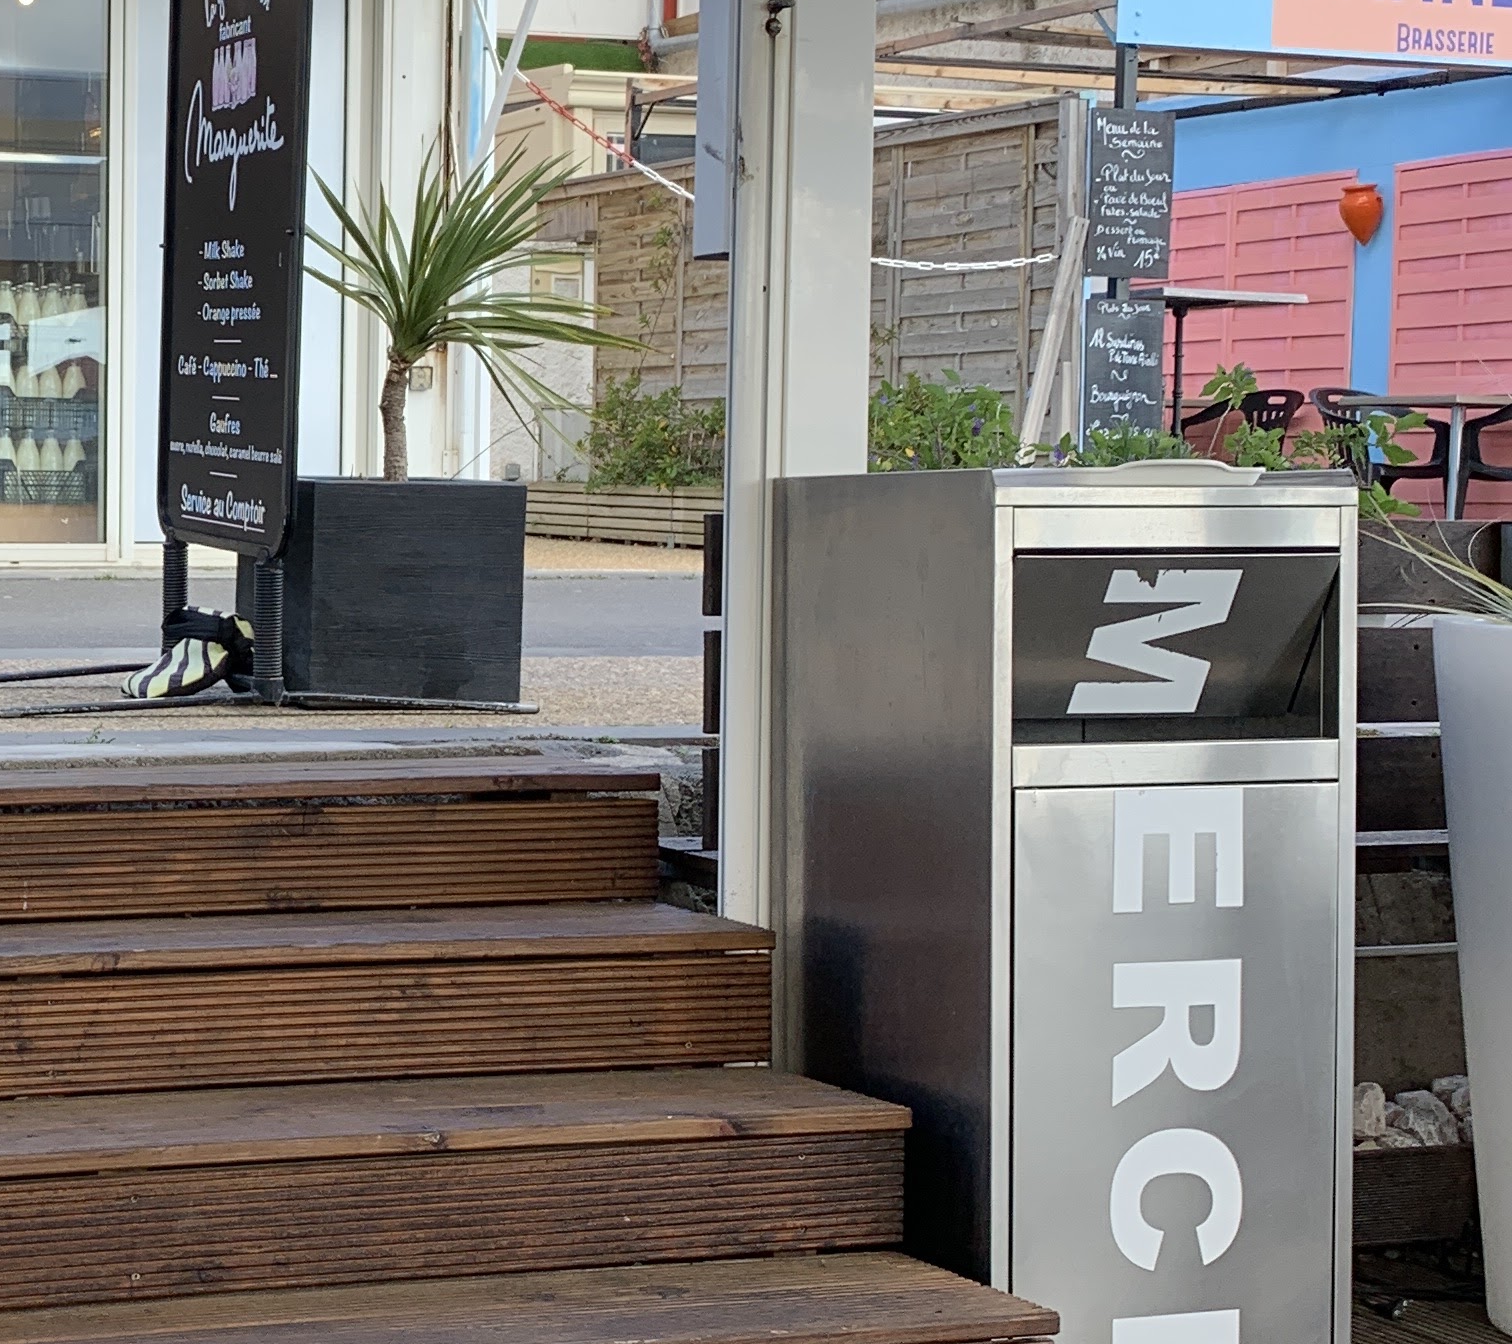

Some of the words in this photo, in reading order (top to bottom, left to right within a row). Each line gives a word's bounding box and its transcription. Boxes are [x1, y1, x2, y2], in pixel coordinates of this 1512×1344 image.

[219, 15, 251, 41] fabricant
[1396, 23, 1494, 54] BRASSERIE
[1096, 117, 1129, 145] Menu
[1129, 120, 1141, 134] de
[184, 79, 285, 212] Marguerite
[1100, 163, 1129, 182] Plat
[1129, 169, 1145, 183] du
[1128, 192, 1139, 205] de
[203, 241, 220, 259] Milk
[221, 238, 245, 258] Shake
[203, 271, 229, 290] Sorbet
[229, 269, 253, 289] Shake
[202, 303, 230, 326] Orange
[230, 302, 261, 326] pressée
[177, 355, 197, 375] Café
[203, 355, 247, 383] Cappuccino
[209, 412, 241, 435] Gaufres
[180, 483, 212, 515] Service
[213, 498, 225, 518] au
[225, 490, 266, 531] Comptoir
